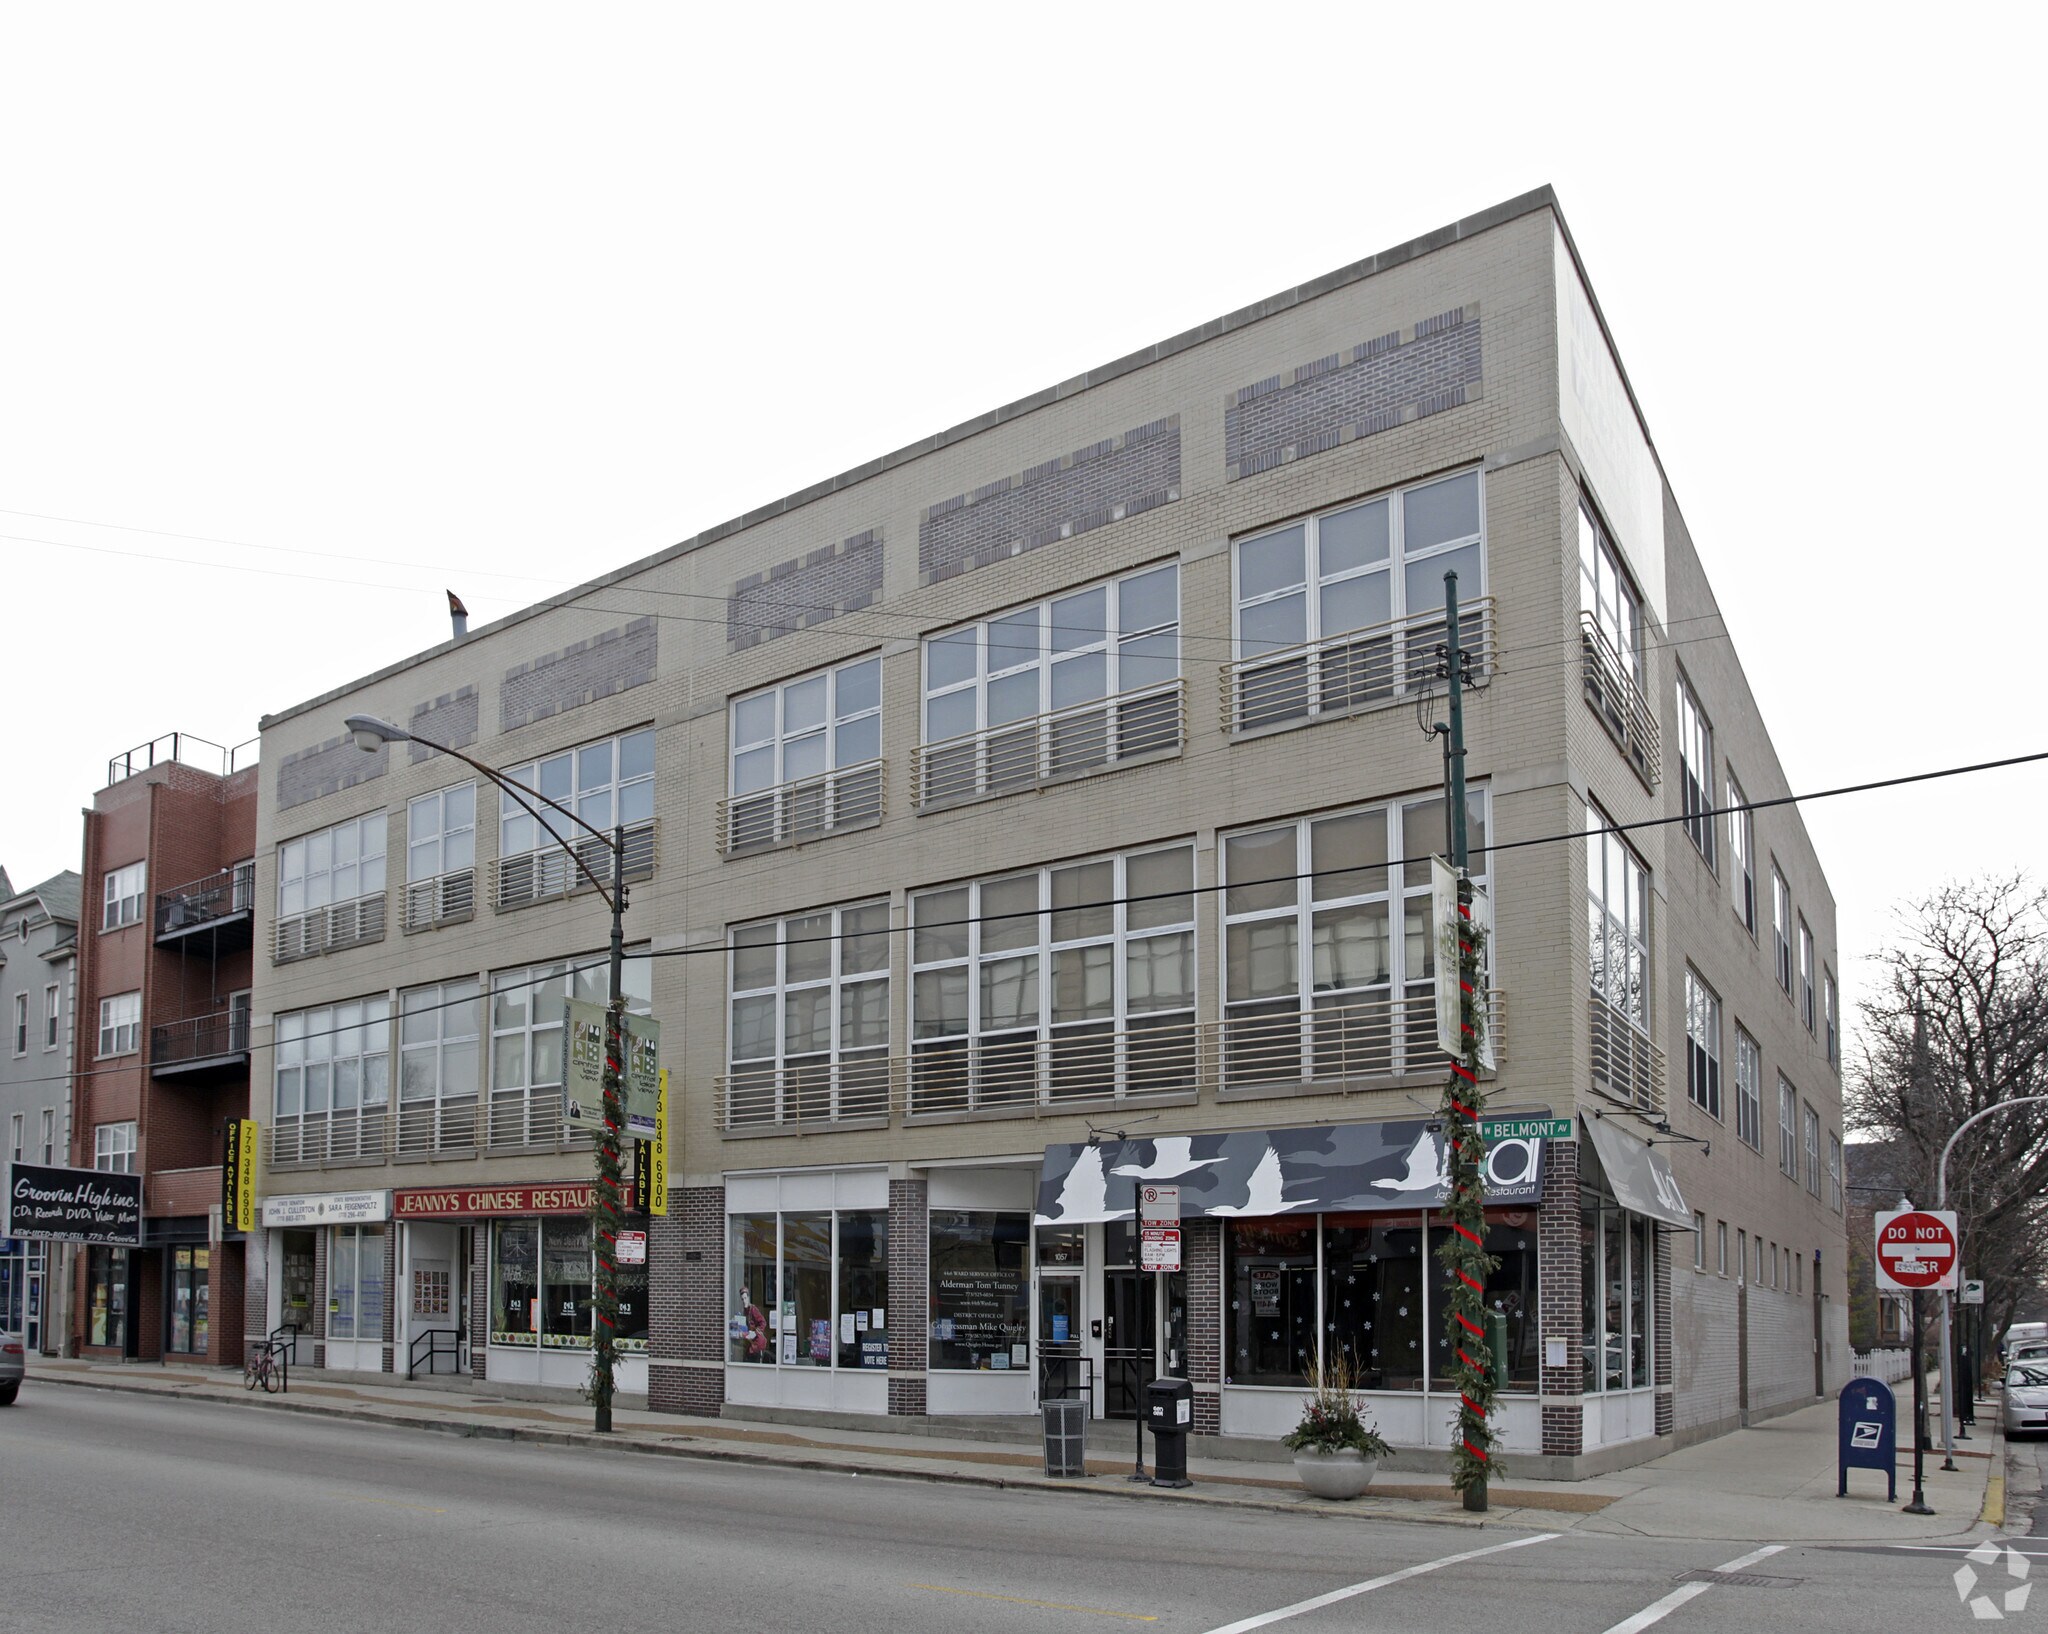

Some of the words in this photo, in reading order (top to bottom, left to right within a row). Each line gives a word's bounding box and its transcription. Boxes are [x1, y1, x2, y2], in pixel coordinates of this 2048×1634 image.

[1484, 1126, 1491, 1135] W
[1494, 1122, 1556, 1138] BELMONT
[1558, 1124, 1568, 1132] AV
[228, 1123, 236, 1162] OFFICE
[638, 1138, 646, 1206] VAILABLE
[14, 1178, 74, 1203] Groovin
[74, 1182, 112, 1210] High
[400, 1193, 460, 1212] JEANNY'S
[468, 1191, 524, 1211] CHINESE
[532, 1187, 630, 1209] RESTAURT
[288, 1206, 316, 1214] CULLERTON
[344, 1202, 377, 1210] FEIGENHOLTZ
[1888, 1227, 1906, 1240] DO
[1916, 1227, 1944, 1239] NOT
[940, 1280, 974, 1288] Alderman
[975, 1281, 992, 1289] Tom
[993, 1282, 1018, 1292] Tunney
[932, 1321, 978, 1331] Congressman
[980, 1322, 997, 1331] Mike
[999, 1323, 1026, 1334] Quigley
[862, 1342, 882, 1352] REGISTER
[864, 1356, 875, 1365] VOTE
[876, 1356, 887, 1365] HERE
